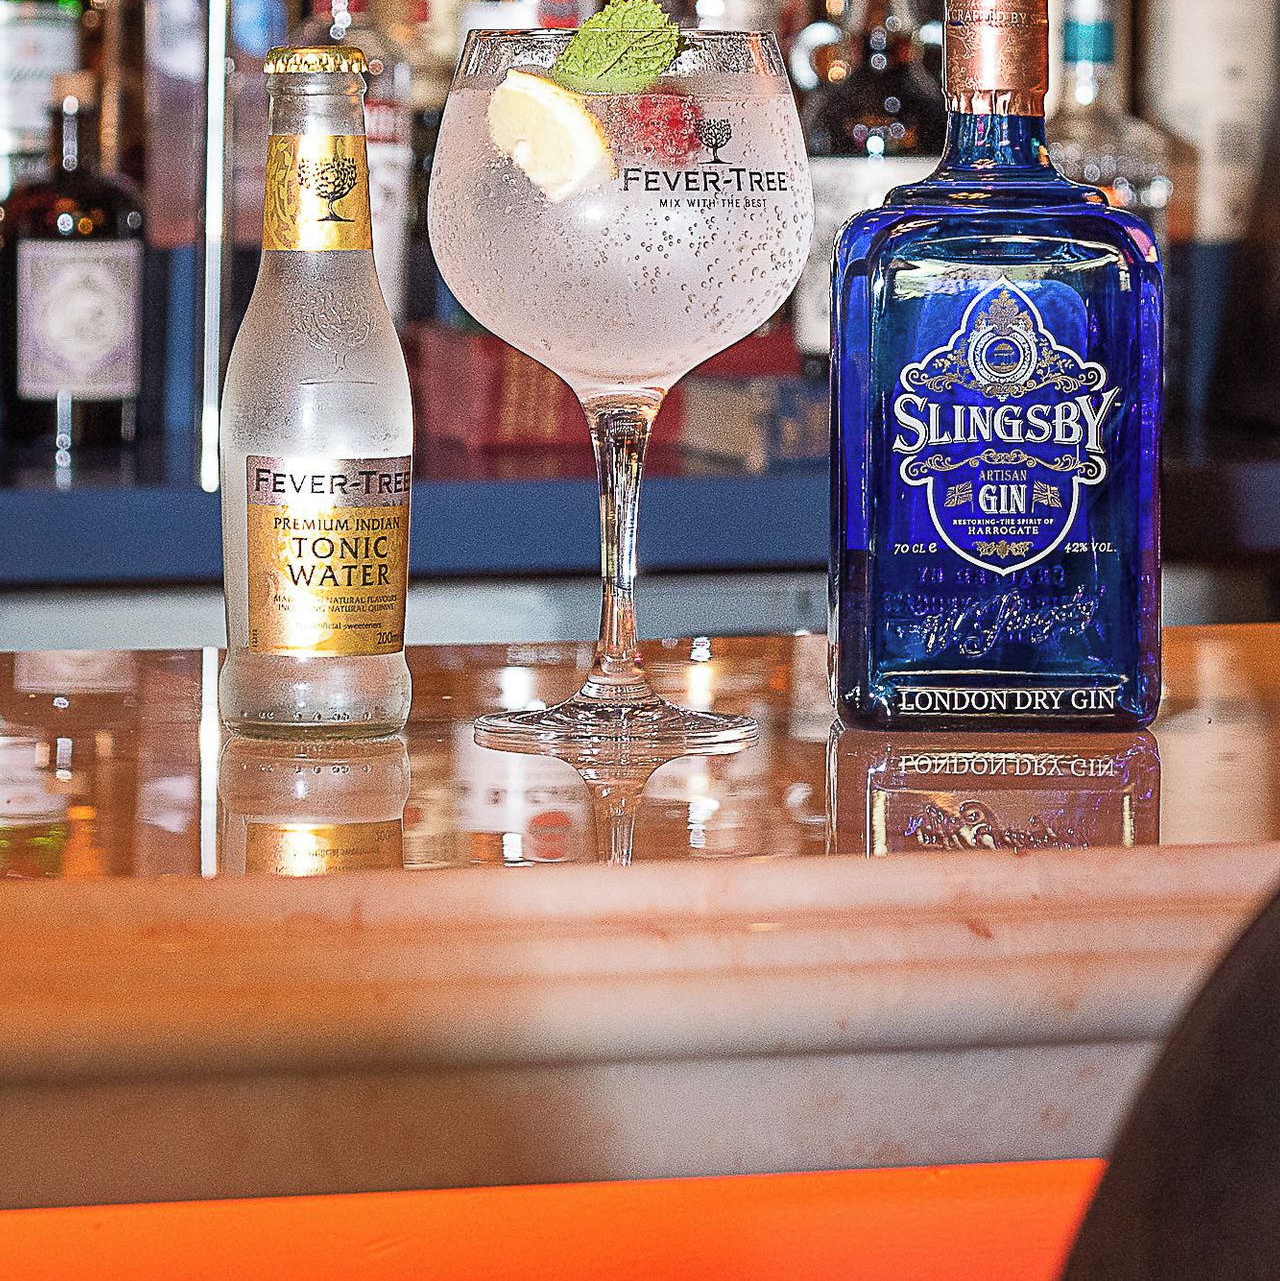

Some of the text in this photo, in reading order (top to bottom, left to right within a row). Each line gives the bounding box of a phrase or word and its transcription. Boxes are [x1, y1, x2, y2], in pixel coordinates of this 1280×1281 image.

[623, 167, 788, 193] FEVER-TREE
[659, 198, 767, 209] MIX WITH THE BEST
[892, 387, 1120, 454] SLINGSBY
[255, 468, 411, 495] FEVER-TREE
[978, 469, 1027, 482] ARTISAN
[977, 483, 1027, 514] GIN
[273, 516, 400, 531] PREMIUM INDIAN
[967, 525, 1040, 536] HARROGATE
[1017, 518, 1043, 526] SPIRIT
[1044, 518, 1055, 526] OF
[291, 535, 388, 559] TONIC
[893, 542, 909, 555] 70
[1064, 541, 1088, 554] 42%
[287, 563, 392, 587] WATER
[899, 690, 1116, 710] LONDON DRY GIN
